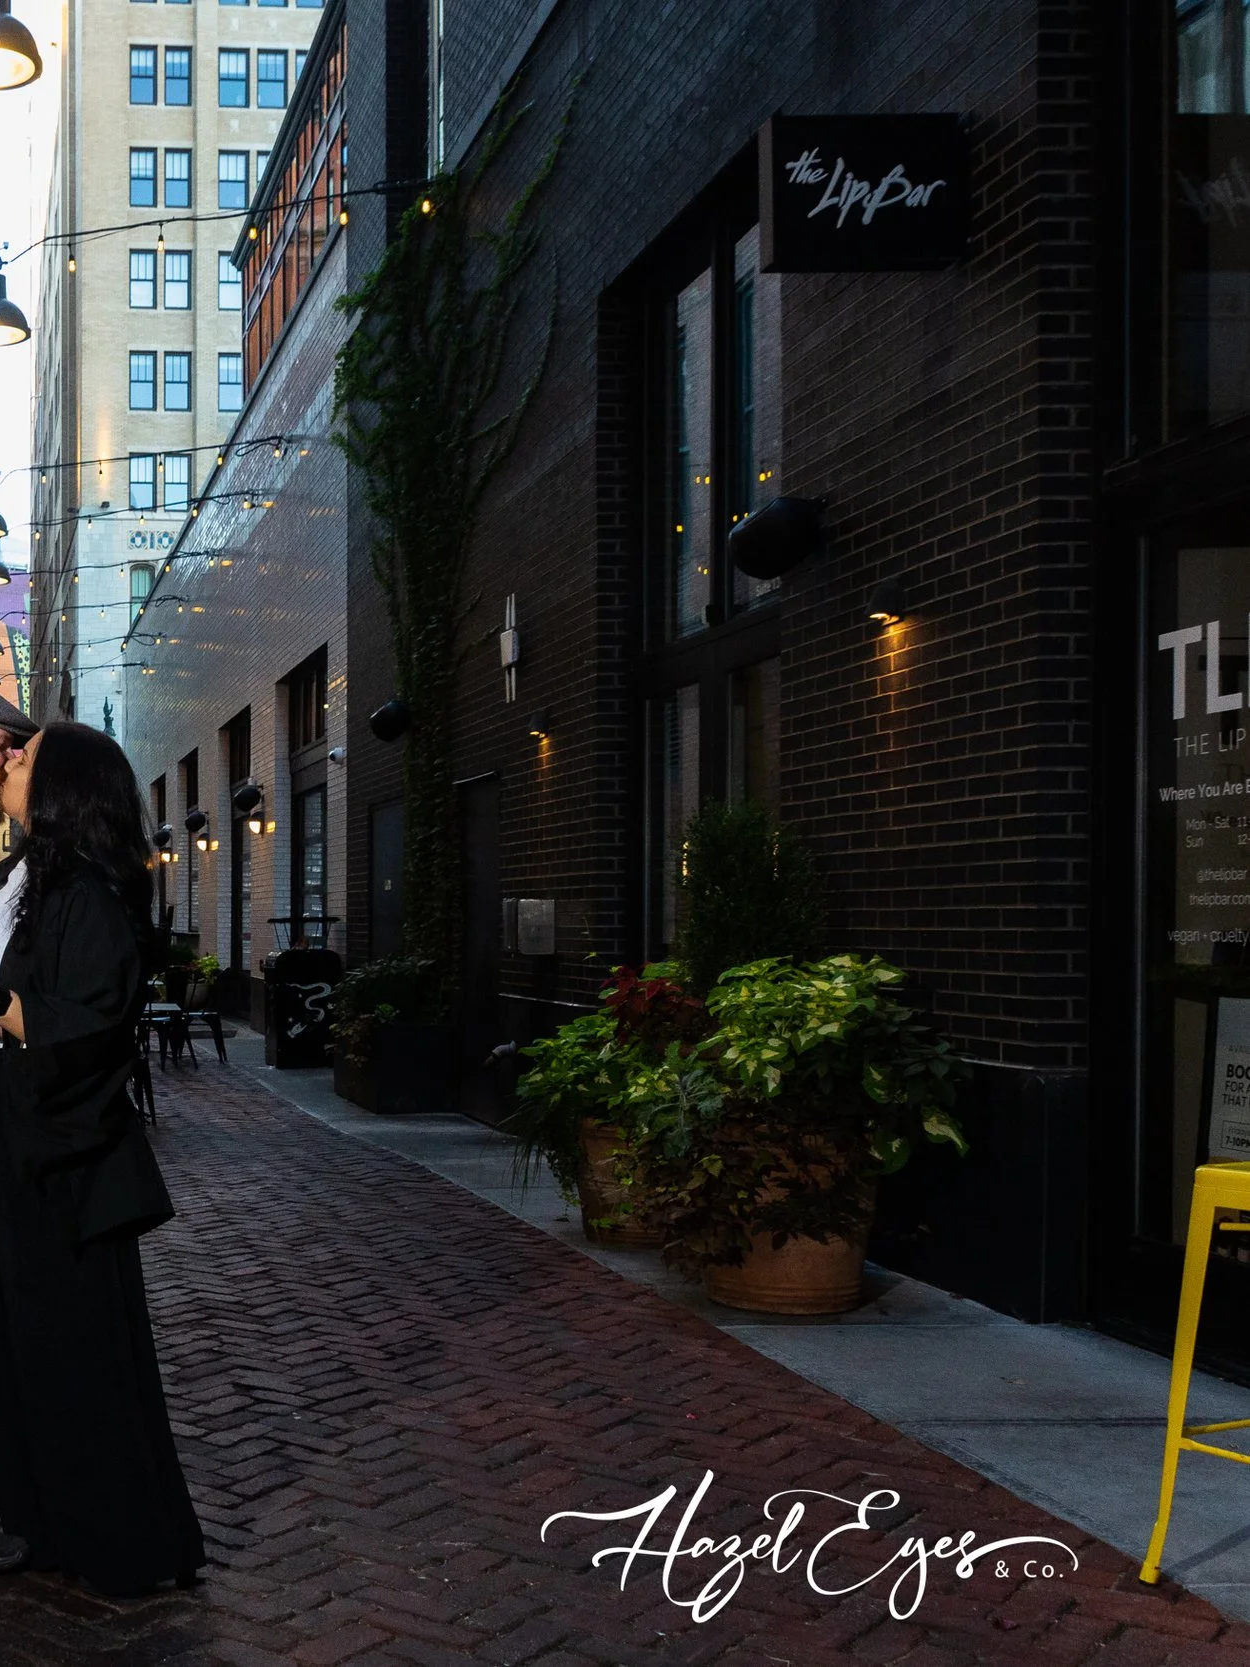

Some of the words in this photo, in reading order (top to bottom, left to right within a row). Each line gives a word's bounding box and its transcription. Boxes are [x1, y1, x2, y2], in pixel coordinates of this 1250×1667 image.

[784, 146, 829, 184] the
[1158, 612, 1250, 720] TL
[1174, 733, 1210, 758] THE
[1219, 727, 1247, 752] LIP
[1158, 786, 1196, 802] Where
[1197, 783, 1221, 798] You
[1222, 780, 1244, 796] Are
[1186, 818, 1207, 831] Mon
[1214, 815, 1231, 829] Sat
[1185, 835, 1204, 848] Sun
[1167, 929, 1200, 945] vegan
[1225, 1081, 1244, 1093] FOR
[1222, 1093, 1247, 1107] THAT
